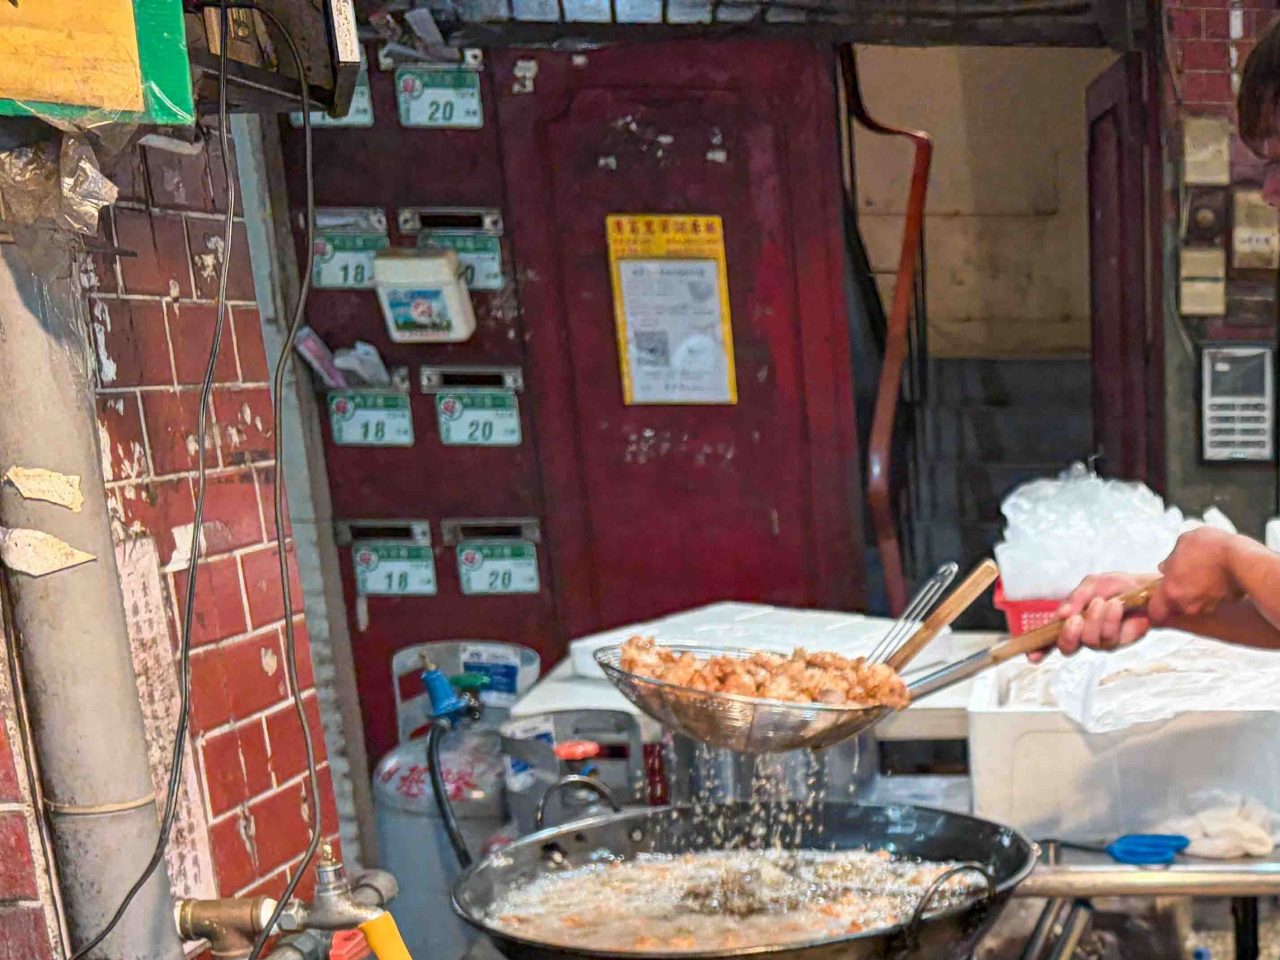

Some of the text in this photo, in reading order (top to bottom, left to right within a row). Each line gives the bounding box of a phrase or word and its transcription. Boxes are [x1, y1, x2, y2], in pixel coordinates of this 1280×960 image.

[428, 100, 455, 122] 20
[339, 263, 365, 283] 18
[360, 420, 386, 441] 18
[468, 420, 494, 441] 20
[488, 570, 513, 591] 20
